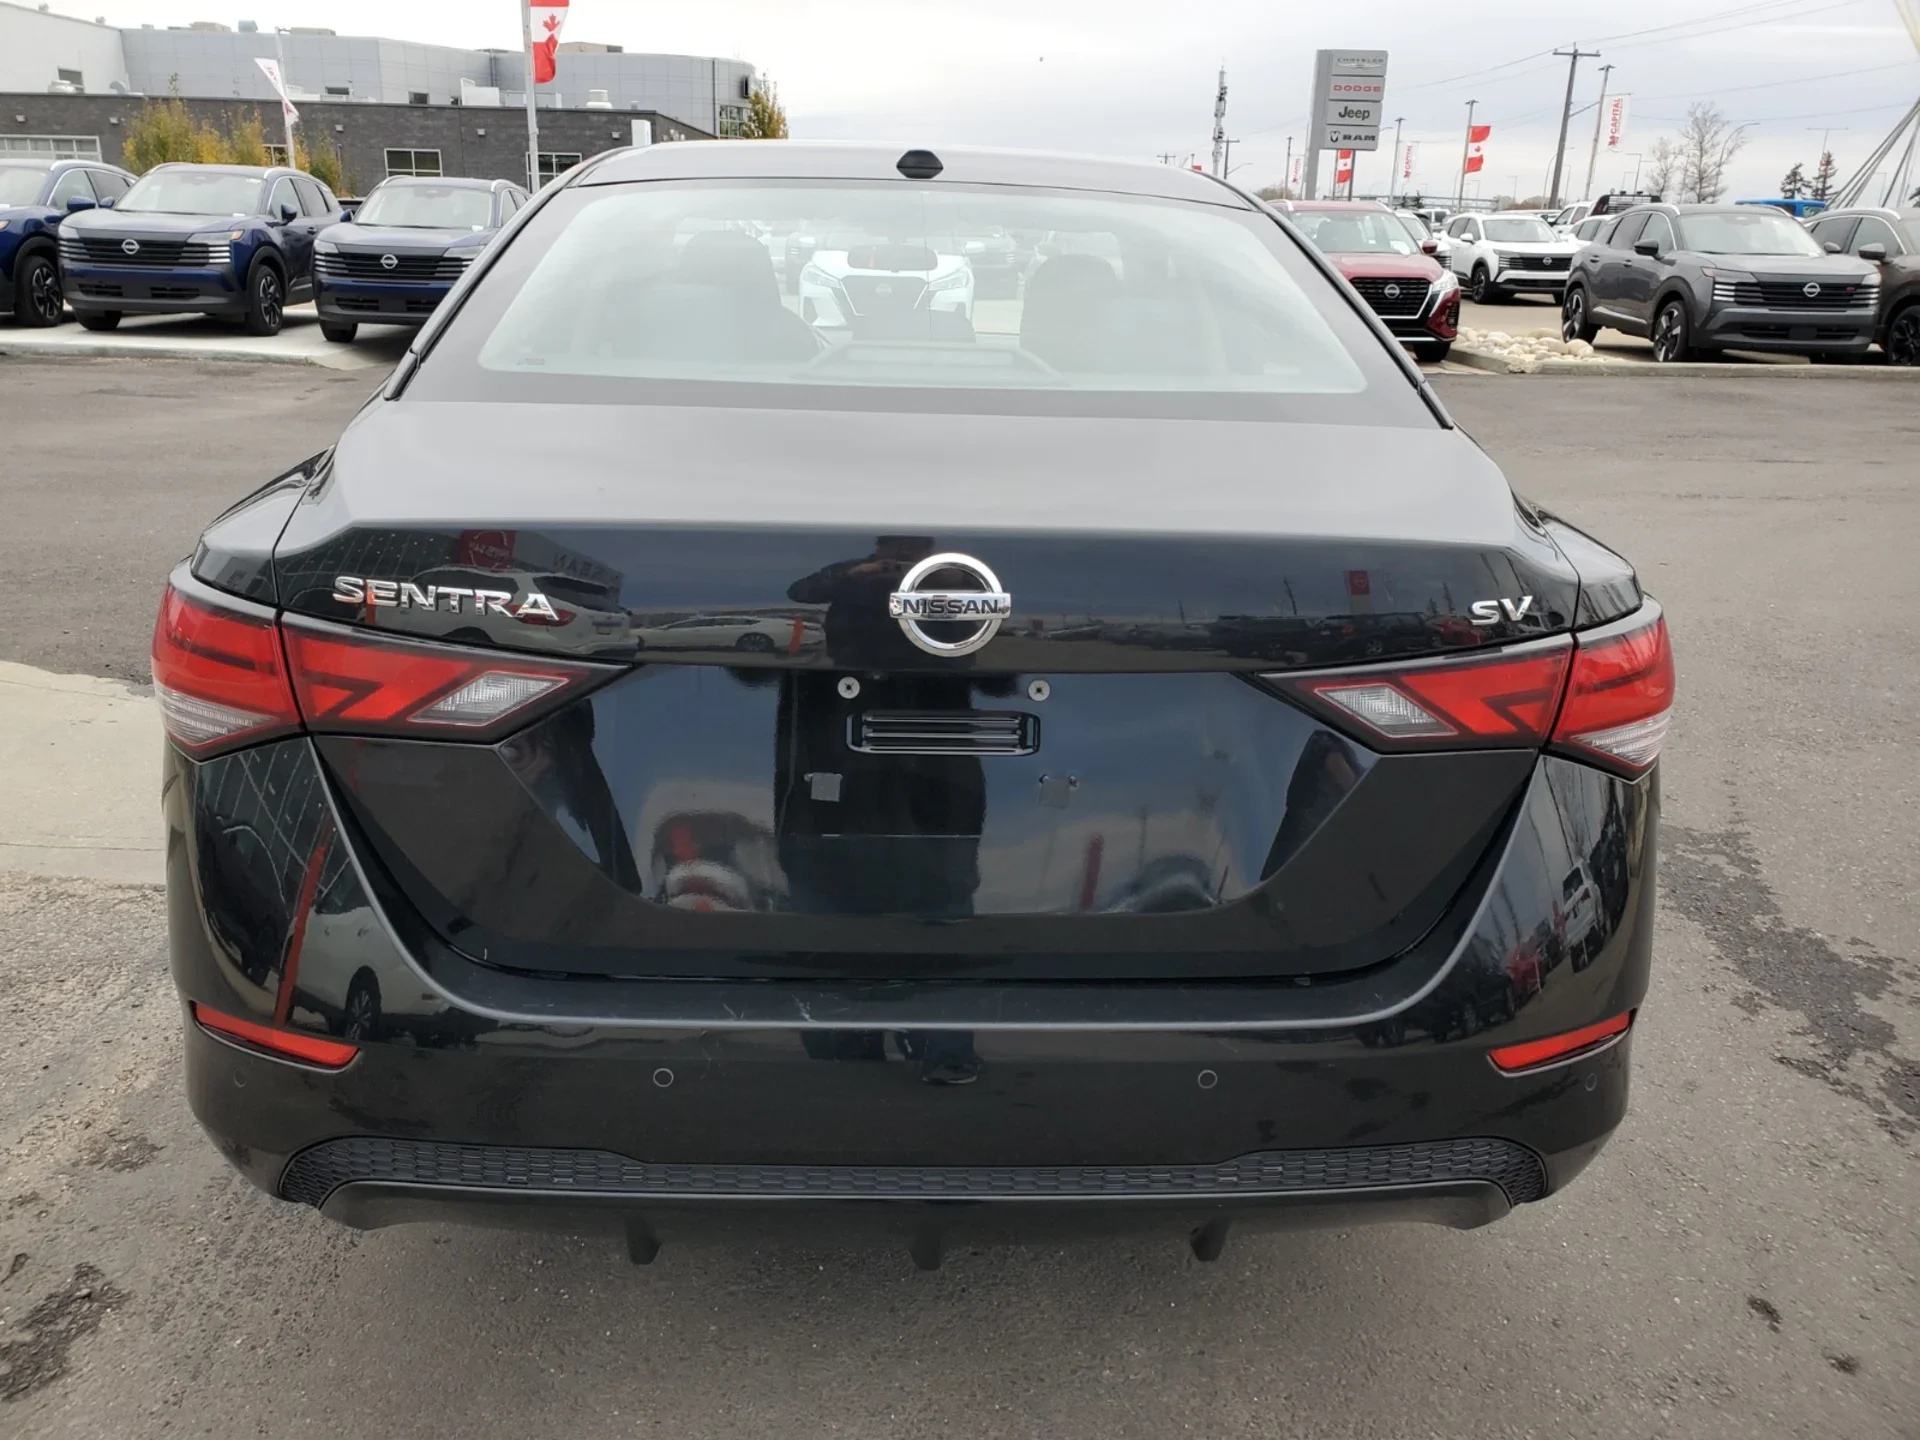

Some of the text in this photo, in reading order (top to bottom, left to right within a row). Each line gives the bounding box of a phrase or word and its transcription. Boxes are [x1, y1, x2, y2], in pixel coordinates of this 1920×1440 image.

[1333, 84, 1381, 92] DODGE
[1338, 106, 1370, 120] Jeep
[1610, 97, 1621, 134] CAPITAL
[332, 576, 559, 621] SENTRA
[903, 599, 999, 614] NISSAN
[1470, 595, 1533, 626] SV
